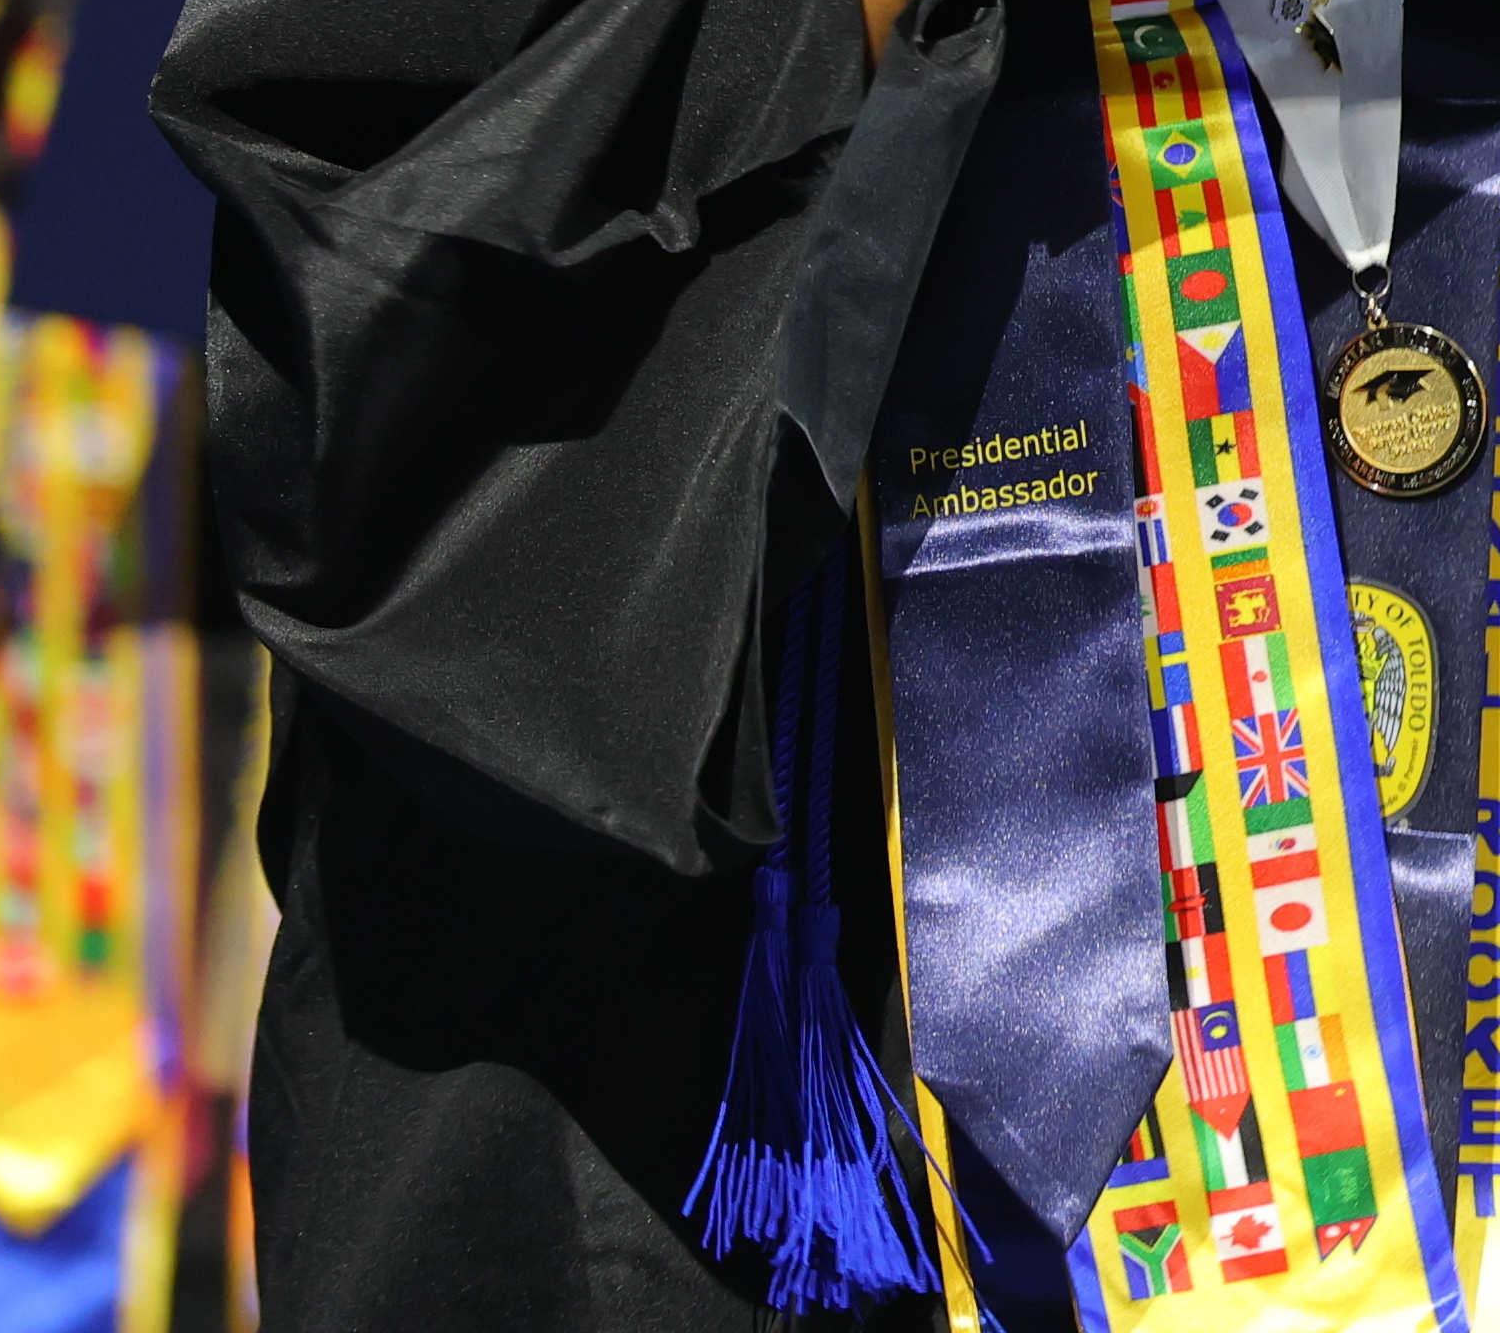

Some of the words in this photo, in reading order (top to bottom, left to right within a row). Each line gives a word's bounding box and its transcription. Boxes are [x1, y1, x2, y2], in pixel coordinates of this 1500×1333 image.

[909, 419, 1088, 474] Presidential
[909, 469, 1098, 520] Ambassador
[1386, 602, 1416, 630] OF
[1407, 635, 1428, 733] TOLEDO
